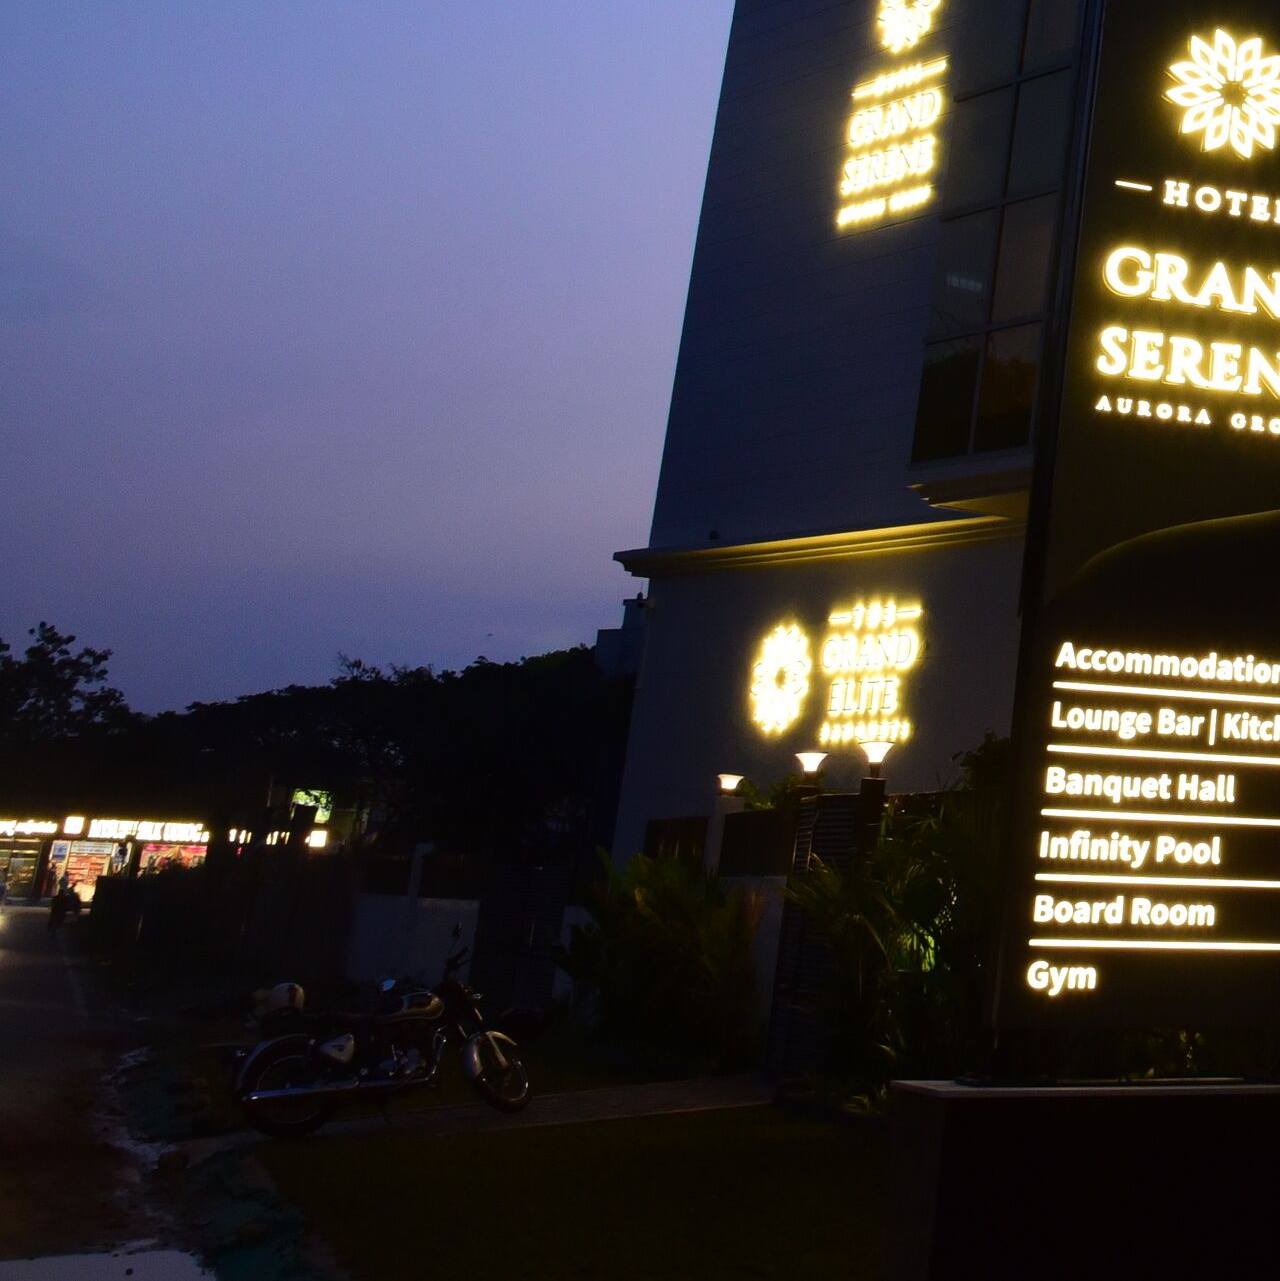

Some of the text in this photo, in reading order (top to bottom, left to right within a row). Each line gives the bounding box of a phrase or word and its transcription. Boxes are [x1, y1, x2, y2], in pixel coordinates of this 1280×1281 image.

[1095, 395, 1211, 425] AURORA
[821, 631, 919, 673] GRAND
[827, 678, 898, 715] ELITE
[1051, 701, 1153, 740] Lounge
[1157, 708, 1206, 737] Bar
[1045, 766, 1236, 804] Banquet Hall
[1039, 829, 1221, 869] Infinity Pool
[1033, 894, 1216, 927] Board Room
[1027, 960, 1097, 996] Gym
